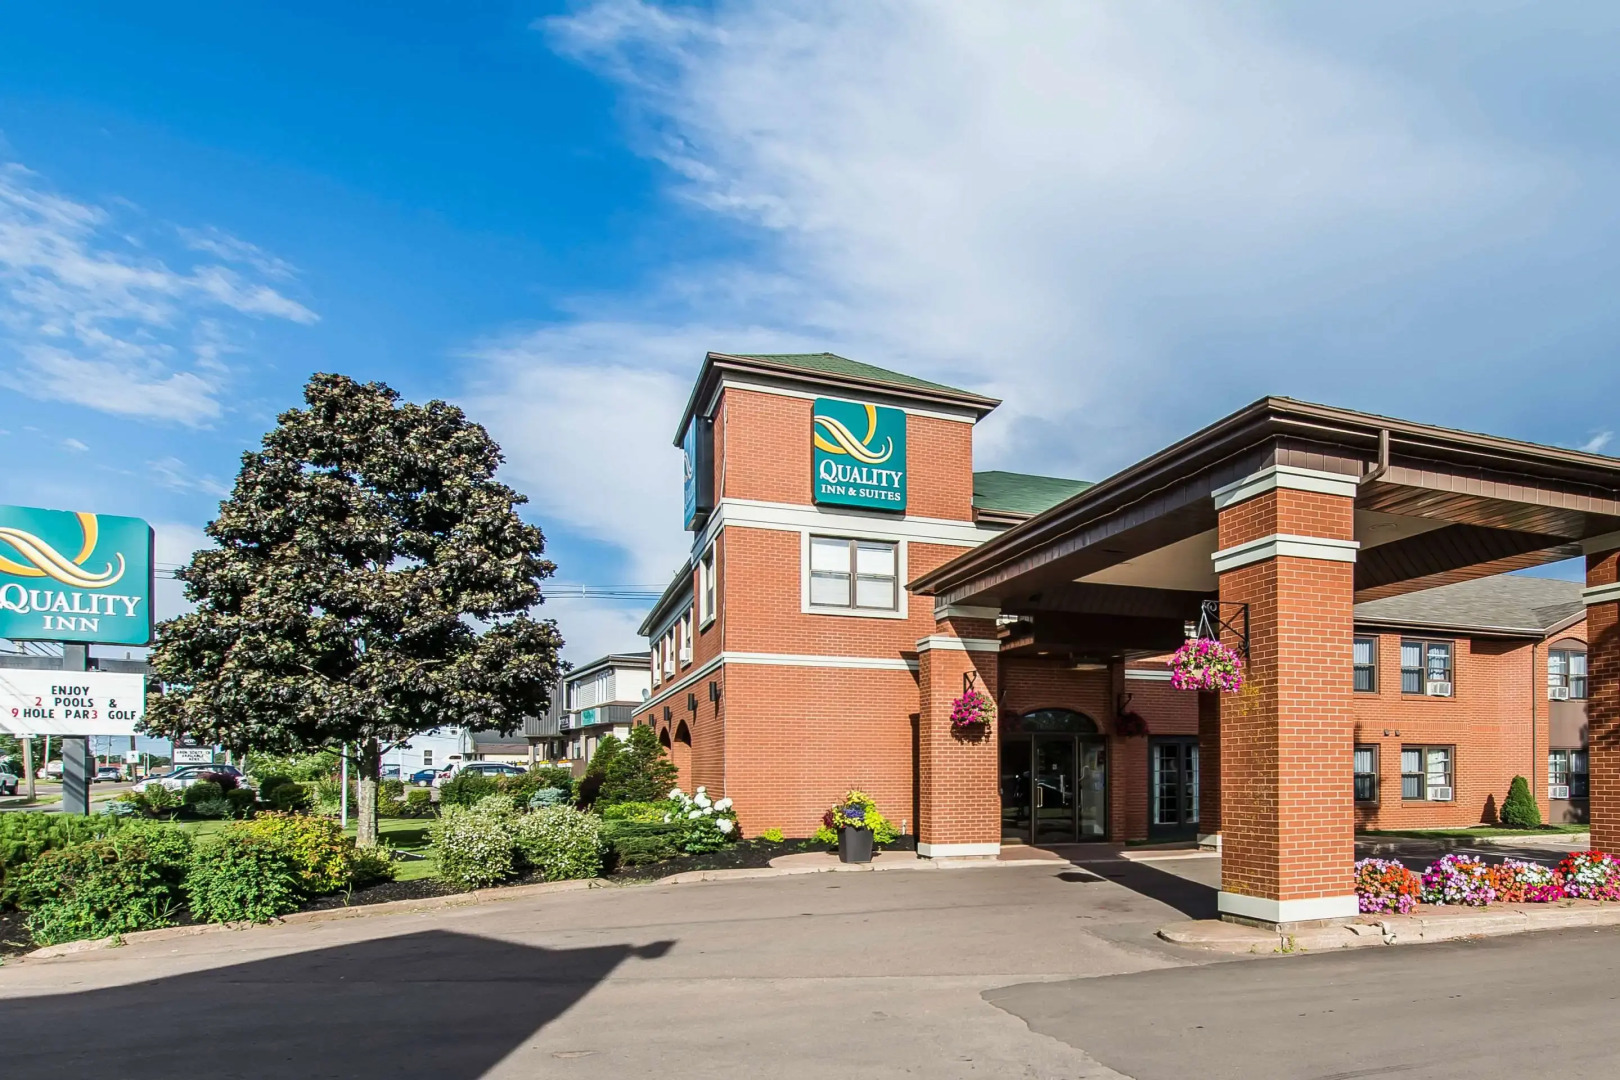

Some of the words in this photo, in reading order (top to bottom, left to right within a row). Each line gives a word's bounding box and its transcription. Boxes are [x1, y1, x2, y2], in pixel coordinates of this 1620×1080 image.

[820, 459, 903, 488] QUALITY
[821, 484, 846, 495] INN
[848, 487, 857, 496] &
[859, 488, 901, 501] SUITES
[0, 583, 142, 617] QUALITY
[42, 615, 100, 632] INN
[51, 685, 90, 696] ENJOY
[35, 697, 42, 707] 2
[54, 697, 94, 708] POOLS
[108, 698, 117, 708] &
[11, 707, 19, 718] 9
[23, 708, 55, 719] HOLE
[108, 710, 136, 720] GOLF
